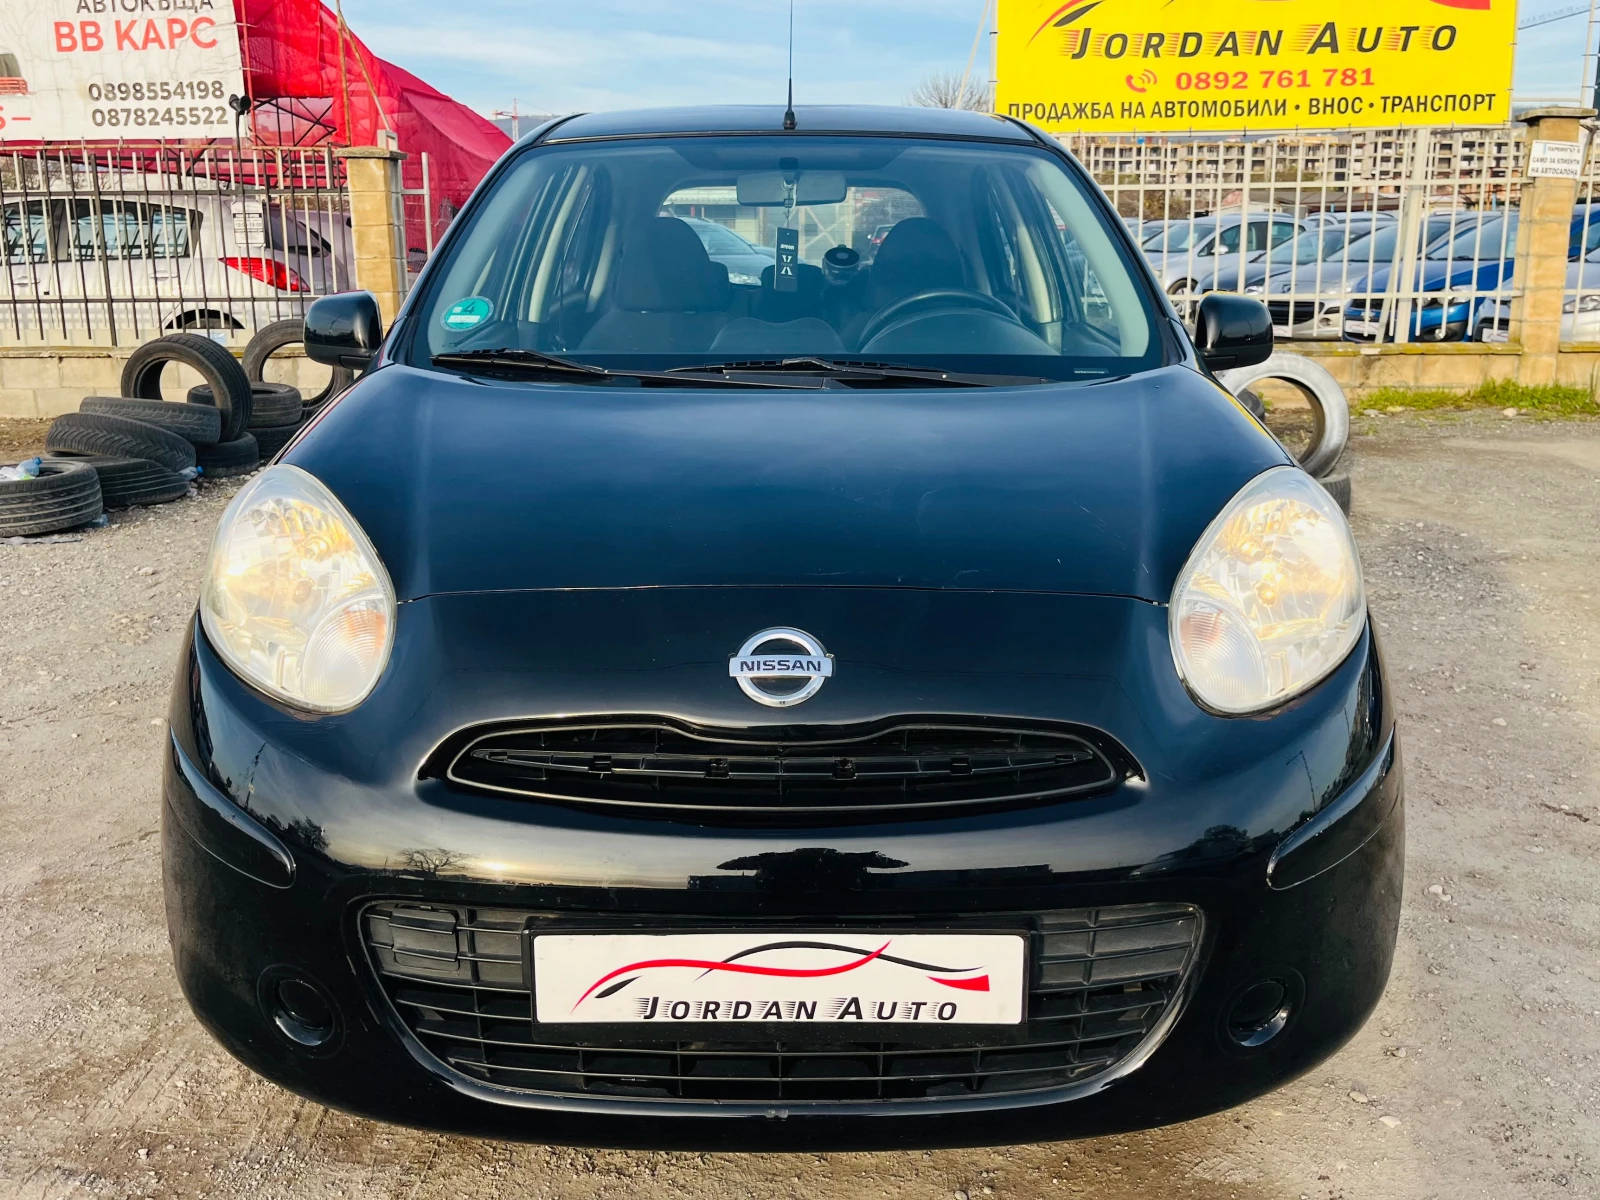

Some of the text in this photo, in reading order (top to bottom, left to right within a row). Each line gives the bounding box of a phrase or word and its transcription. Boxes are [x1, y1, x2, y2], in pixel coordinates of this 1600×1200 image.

[114, 16, 219, 51] КАРС
[1069, 21, 1457, 60] JORDAN AUTO
[1175, 67, 1375, 90] 0892 761 781
[88, 80, 225, 101] 0898554198
[91, 106, 229, 127] 0878245522
[1007, 93, 1496, 123] ПРОДАЖБА НА АВТОМОБИЛИ ВНОС ТРАНСПОРТ
[463, 300, 477, 314] 4
[740, 659, 822, 672] NISSAN
[642, 996, 958, 1021] JORDAN AUTO
